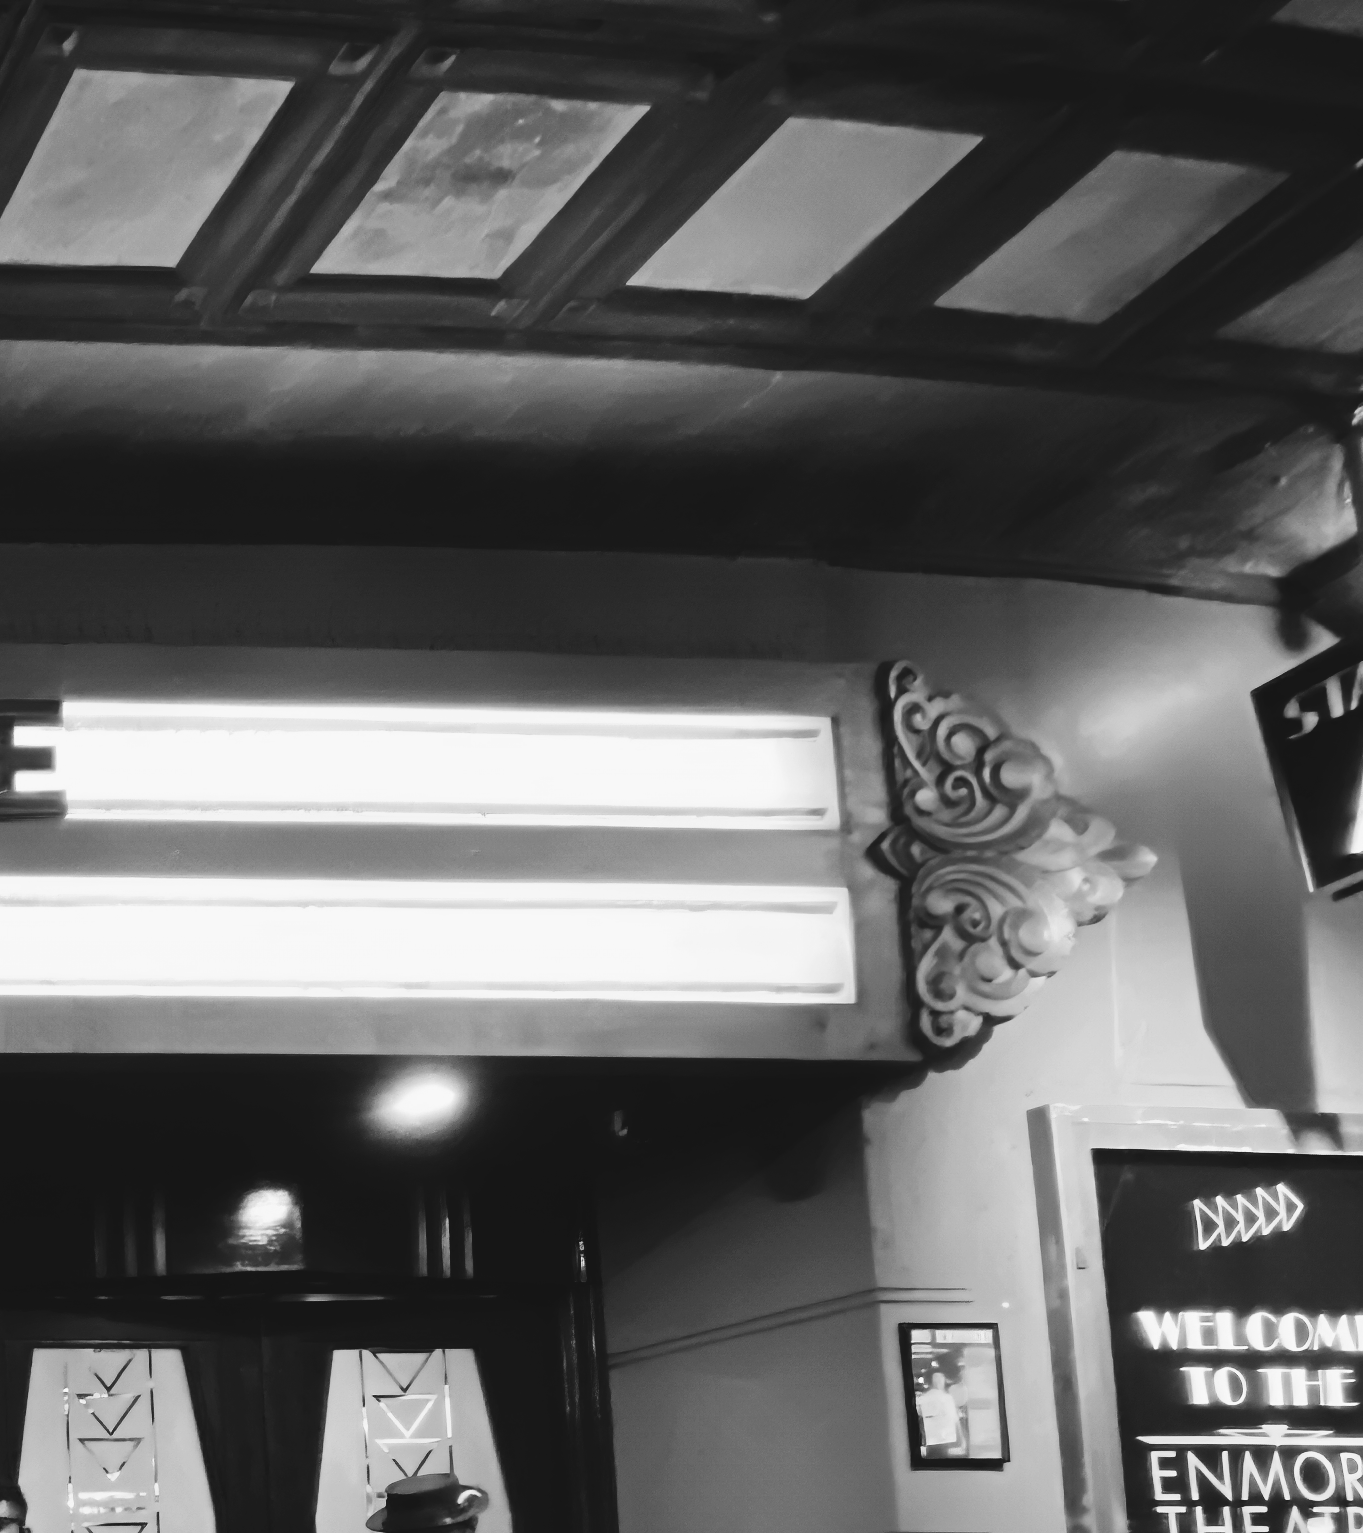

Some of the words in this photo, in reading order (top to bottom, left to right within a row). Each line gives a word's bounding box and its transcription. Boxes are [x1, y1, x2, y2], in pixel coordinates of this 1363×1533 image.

[1133, 1310, 1363, 1352] WELCOM
[1179, 1366, 1248, 1406] TO
[1256, 1367, 1360, 1407] THE
